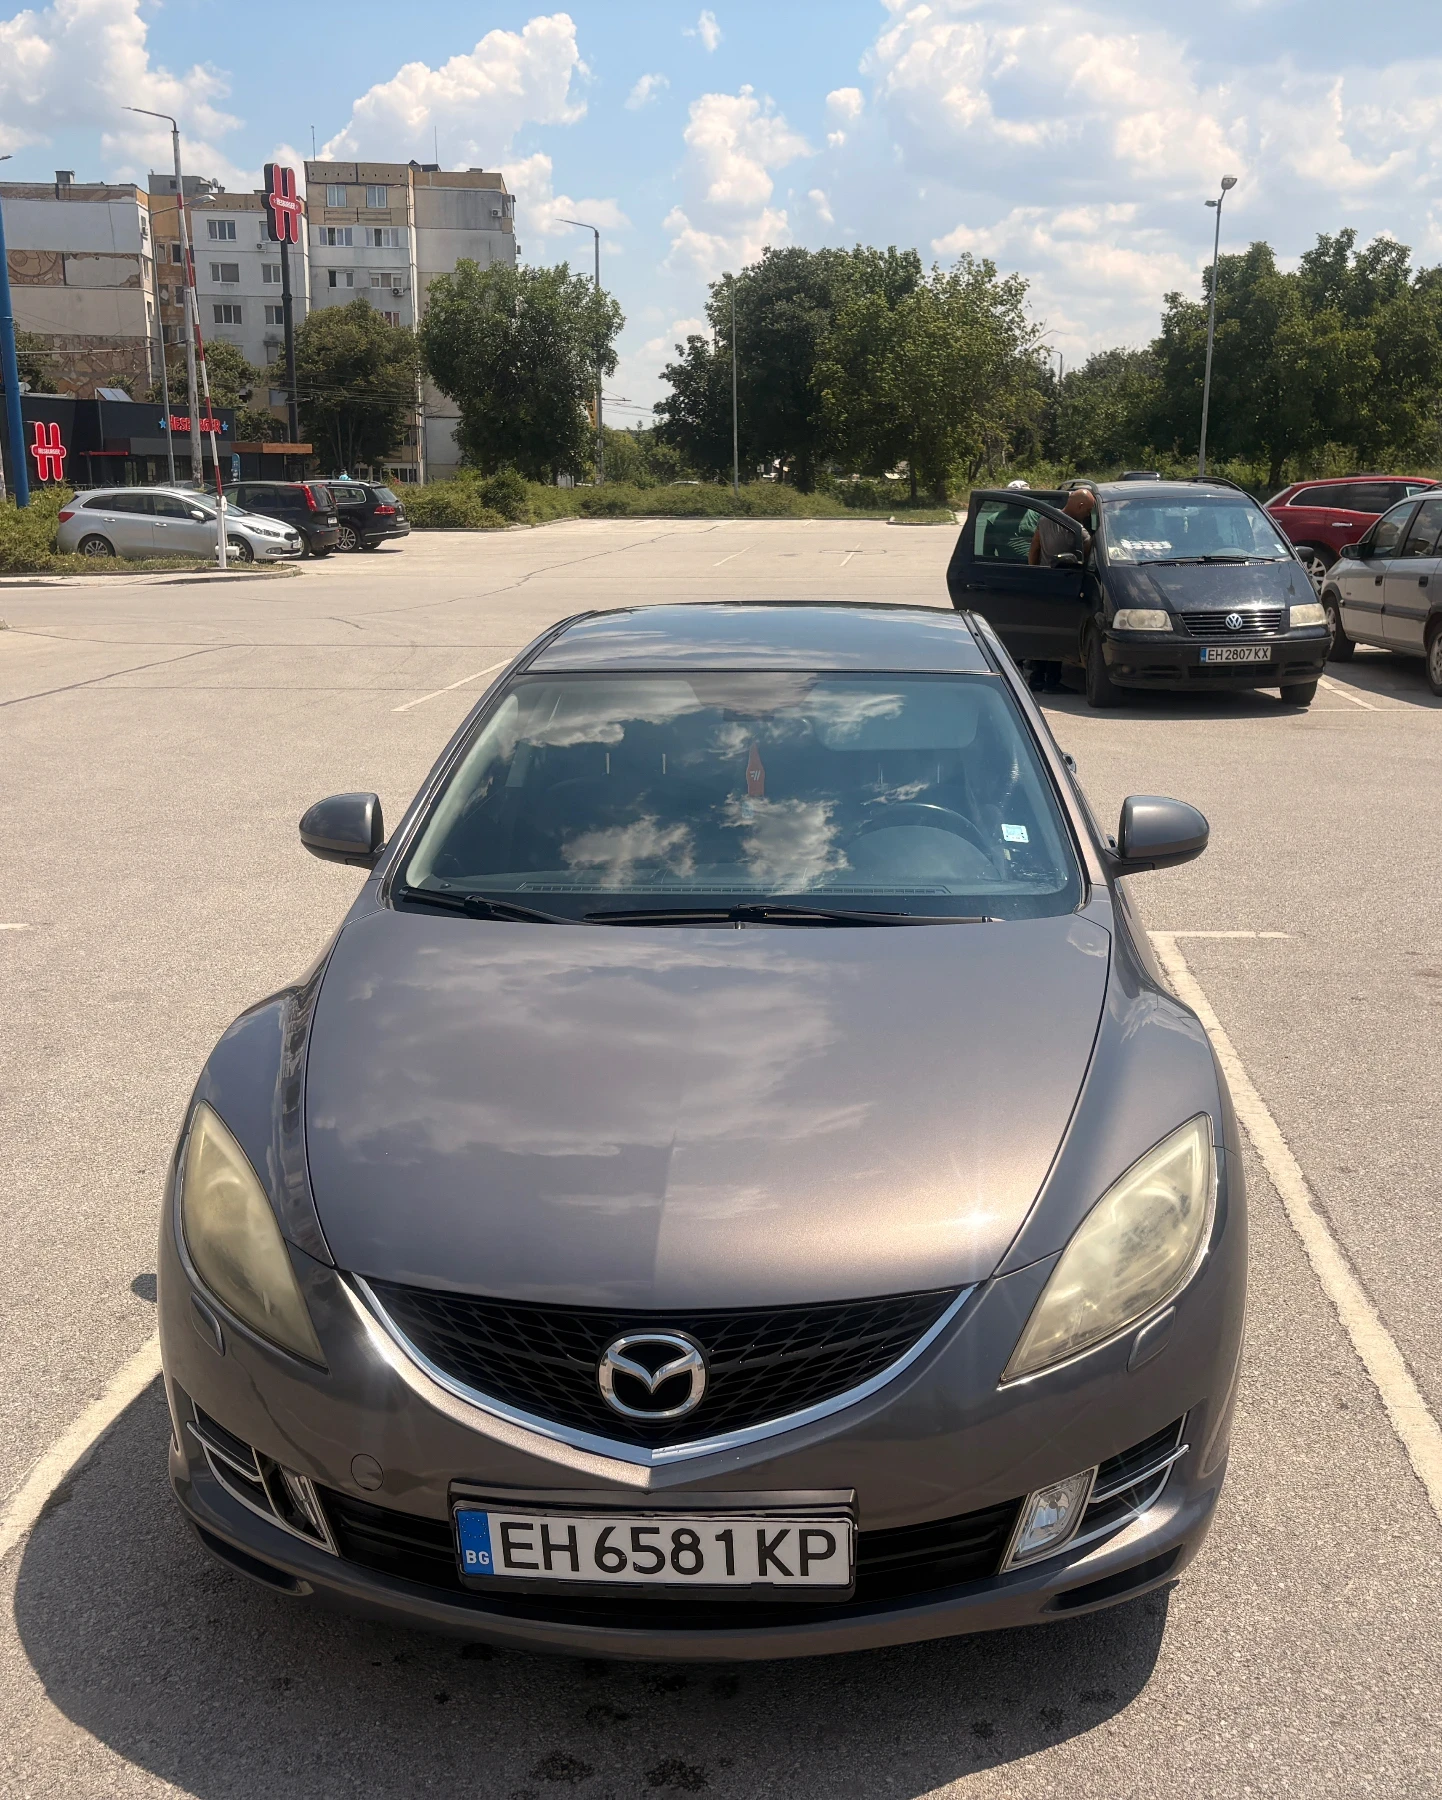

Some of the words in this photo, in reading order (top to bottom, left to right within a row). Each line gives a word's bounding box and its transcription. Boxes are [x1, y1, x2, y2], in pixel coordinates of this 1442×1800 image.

[1207, 649, 1223, 661] EH
[1225, 648, 1253, 661] 2807
[1254, 647, 1269, 660] KX
[465, 1548, 490, 1566] BG
[499, 1521, 580, 1572] EH
[594, 1525, 736, 1576] 6581
[756, 1528, 837, 1577] KP
